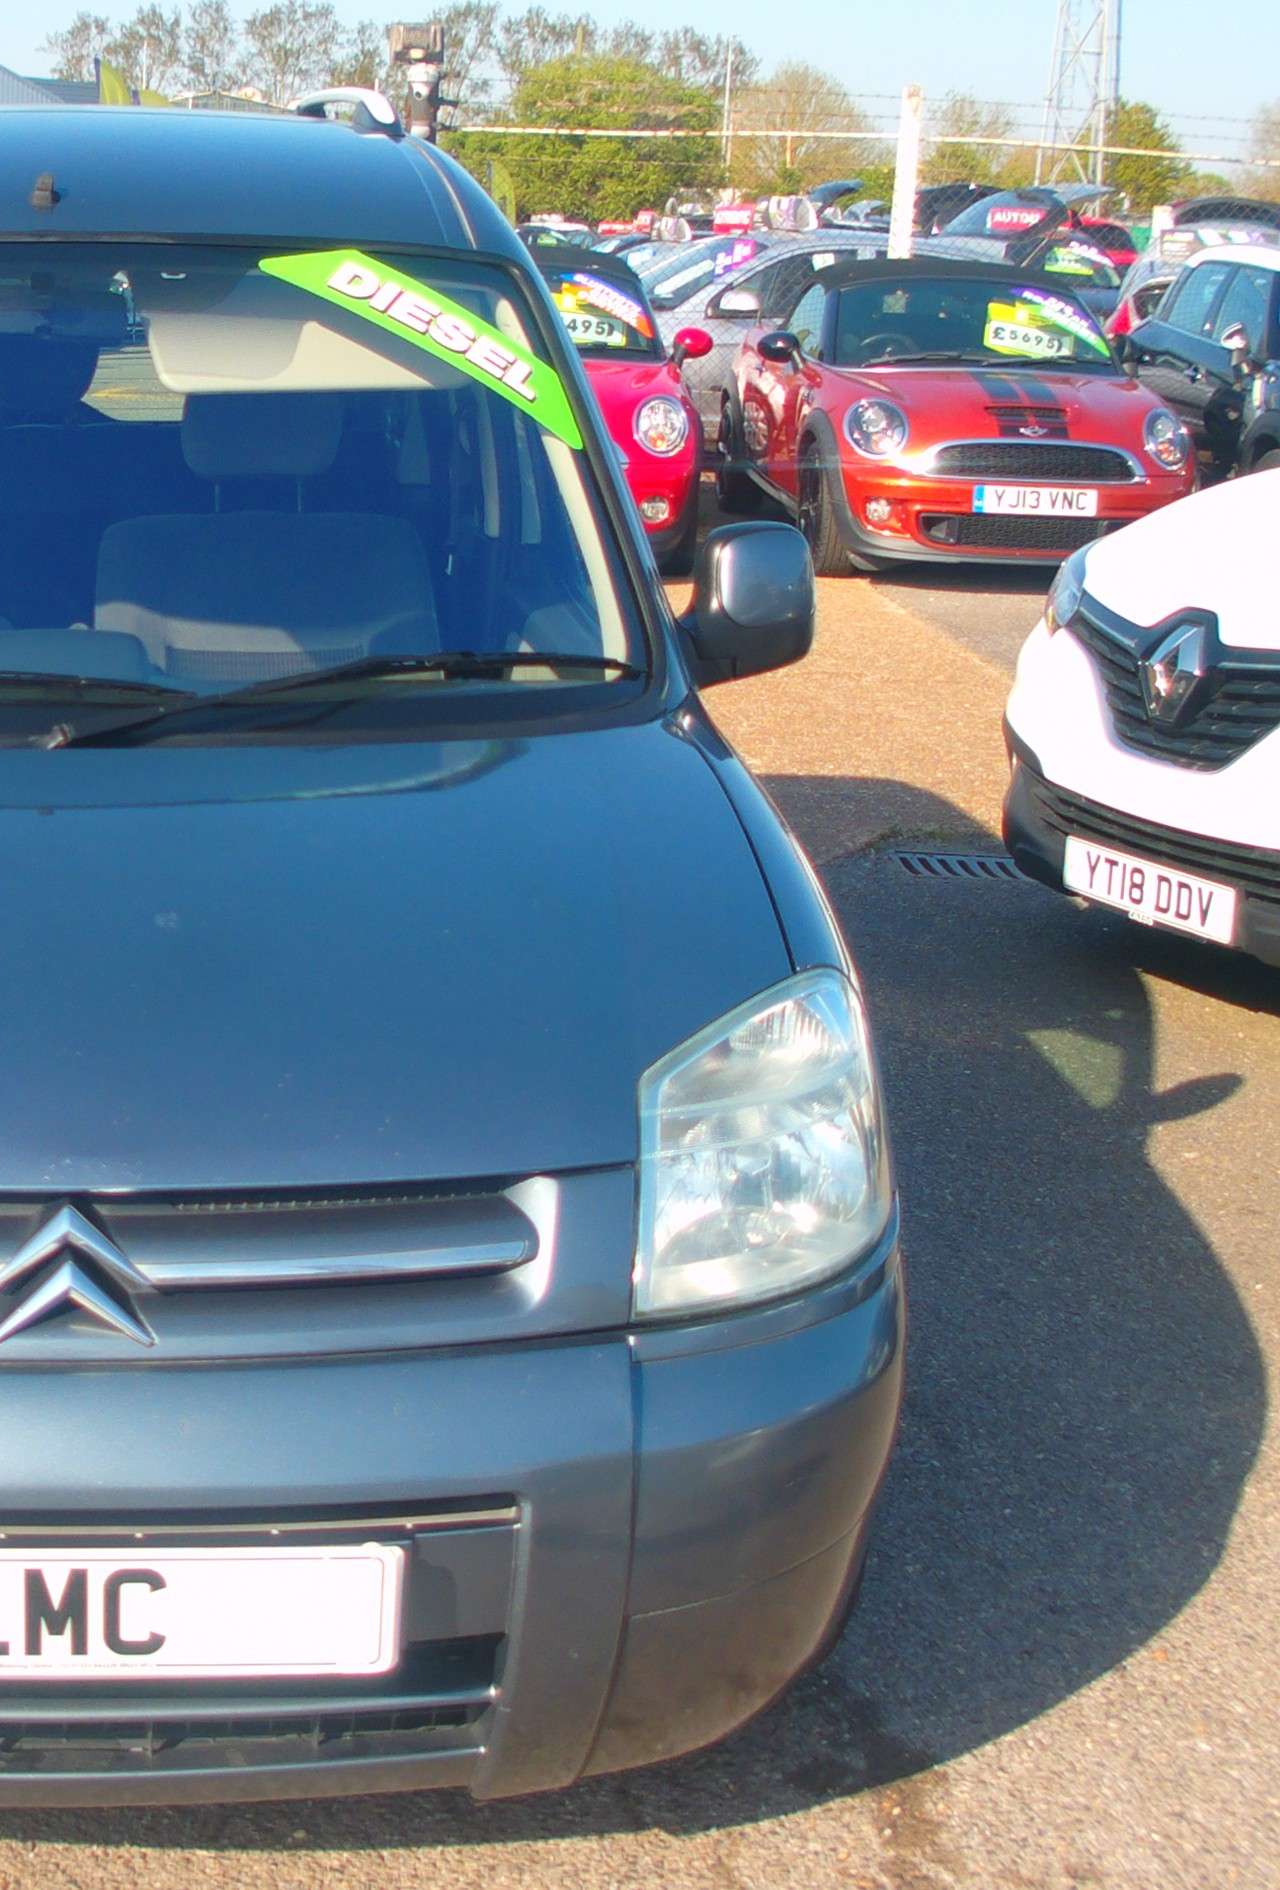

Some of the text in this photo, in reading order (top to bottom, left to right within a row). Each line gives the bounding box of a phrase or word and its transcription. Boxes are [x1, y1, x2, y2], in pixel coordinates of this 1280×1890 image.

[327, 261, 537, 404] DIESEL
[994, 488, 1088, 511] YJ13 VNC
[1086, 850, 1215, 928] YT18 DDV
